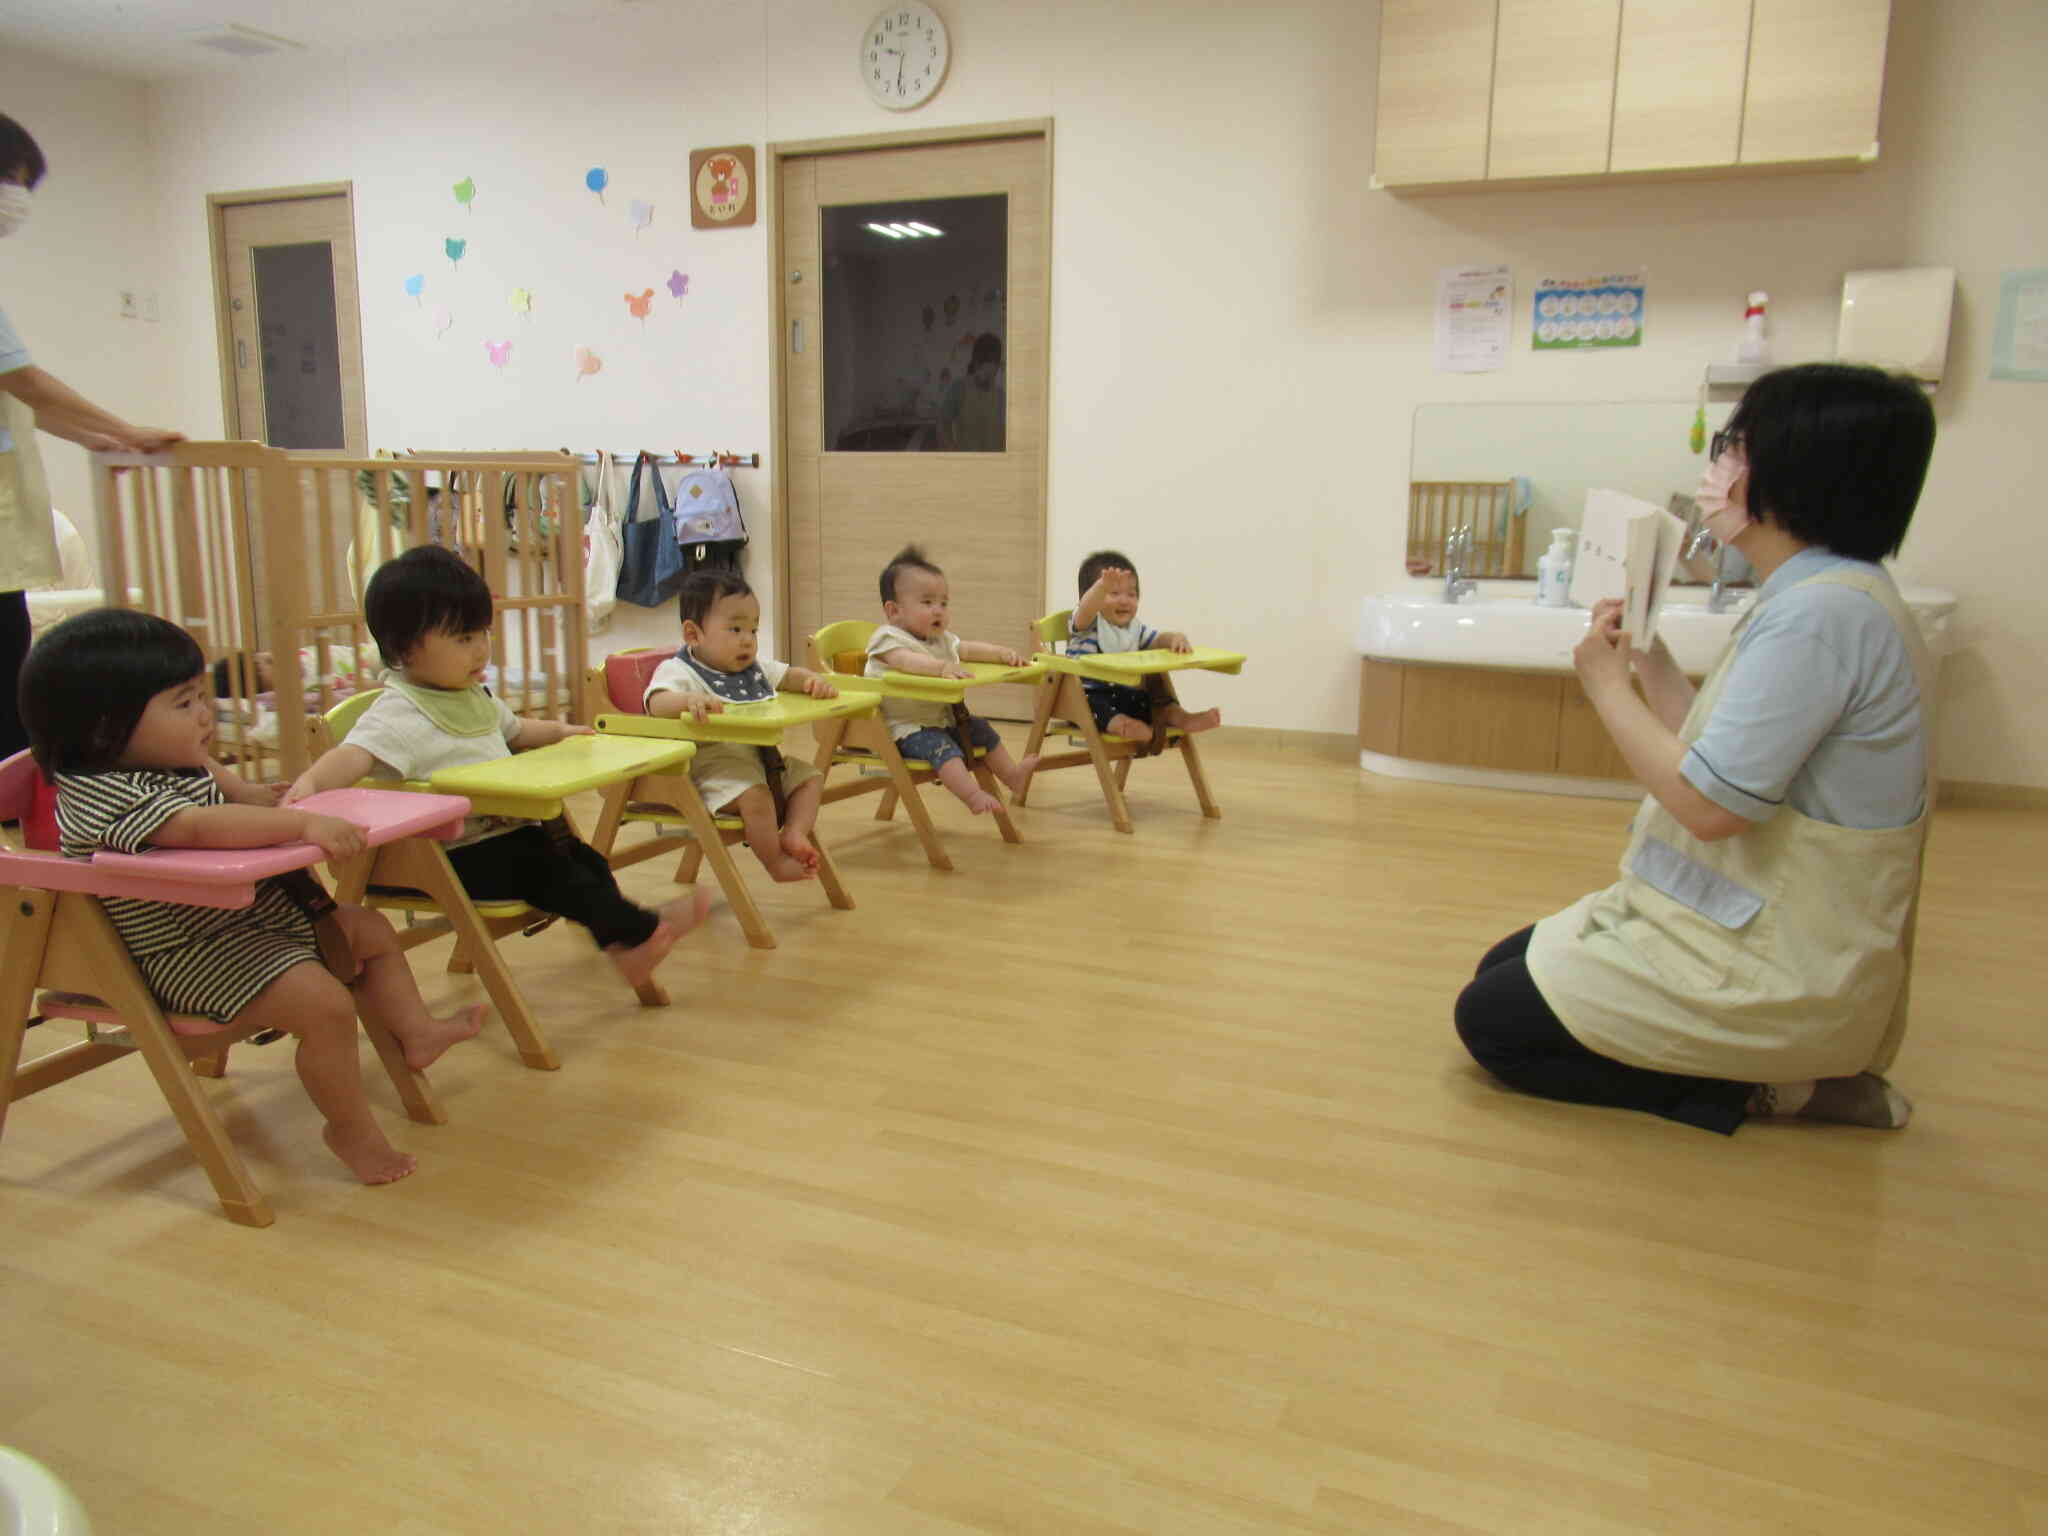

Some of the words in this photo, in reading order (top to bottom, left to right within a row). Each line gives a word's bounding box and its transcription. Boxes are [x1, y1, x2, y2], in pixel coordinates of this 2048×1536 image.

[885, 19, 893, 32] 11
[898, 13, 910, 26] 12
[874, 33, 884, 45] 10
[870, 50, 878, 62] 9
[930, 46, 937, 58] 3
[873, 68, 881, 80] 8
